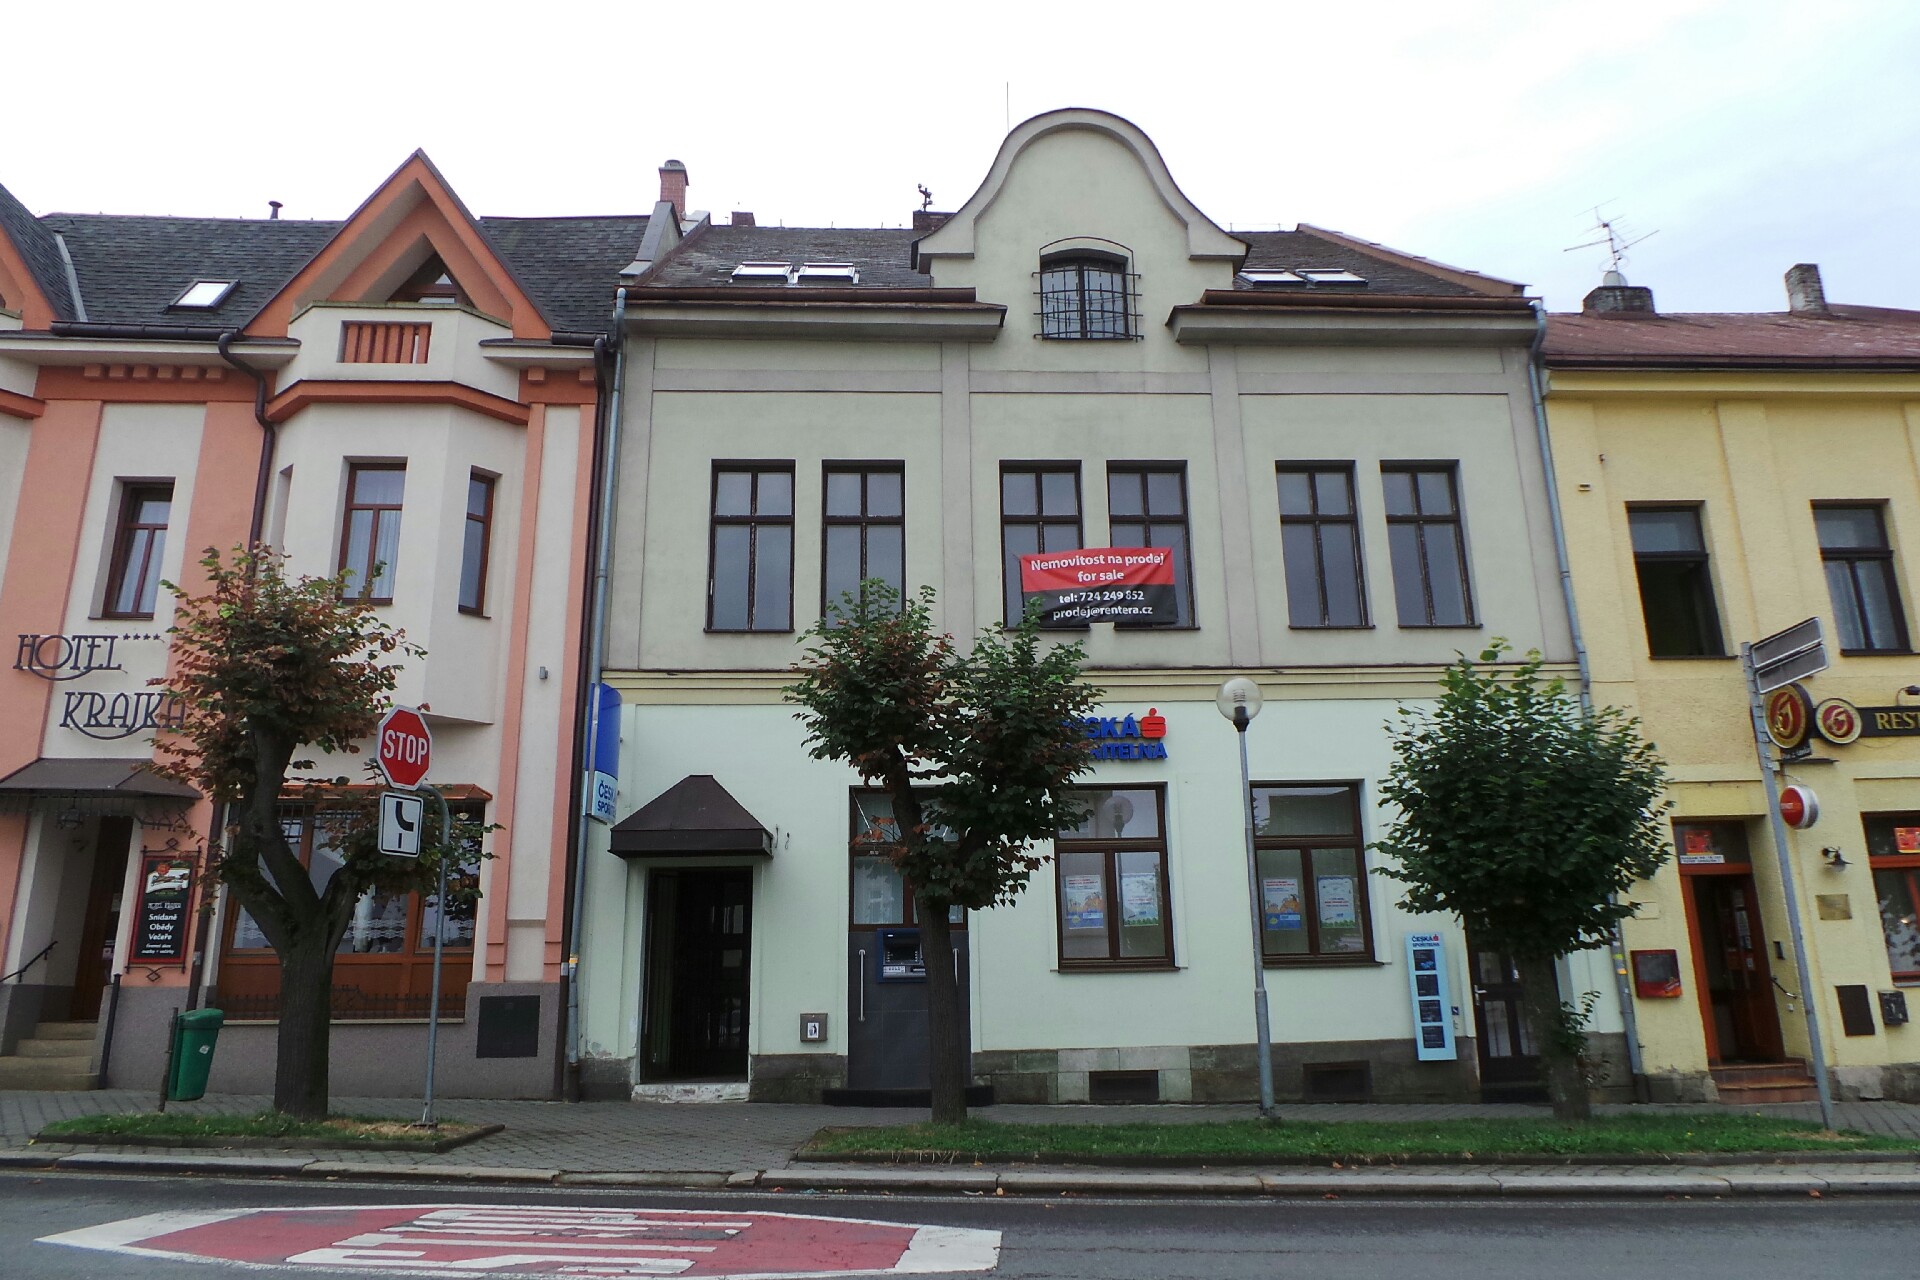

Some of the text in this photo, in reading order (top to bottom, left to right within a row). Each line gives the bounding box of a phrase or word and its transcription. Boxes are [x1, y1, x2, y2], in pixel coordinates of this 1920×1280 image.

[1031, 553, 1164, 571] Nemovitost na prodej
[1078, 570, 1124, 582] for sale
[1059, 590, 1144, 603] tel: 724 249 852
[1053, 606, 1153, 620] prodej@rentera.cz
[13, 634, 122, 681] HOTEL
[59, 692, 188, 740] KRAJKA
[1874, 712, 1920, 730] RES
[383, 729, 428, 766] STOP
[149, 923, 174, 932] Obědy
[148, 933, 172, 941] Večeře
